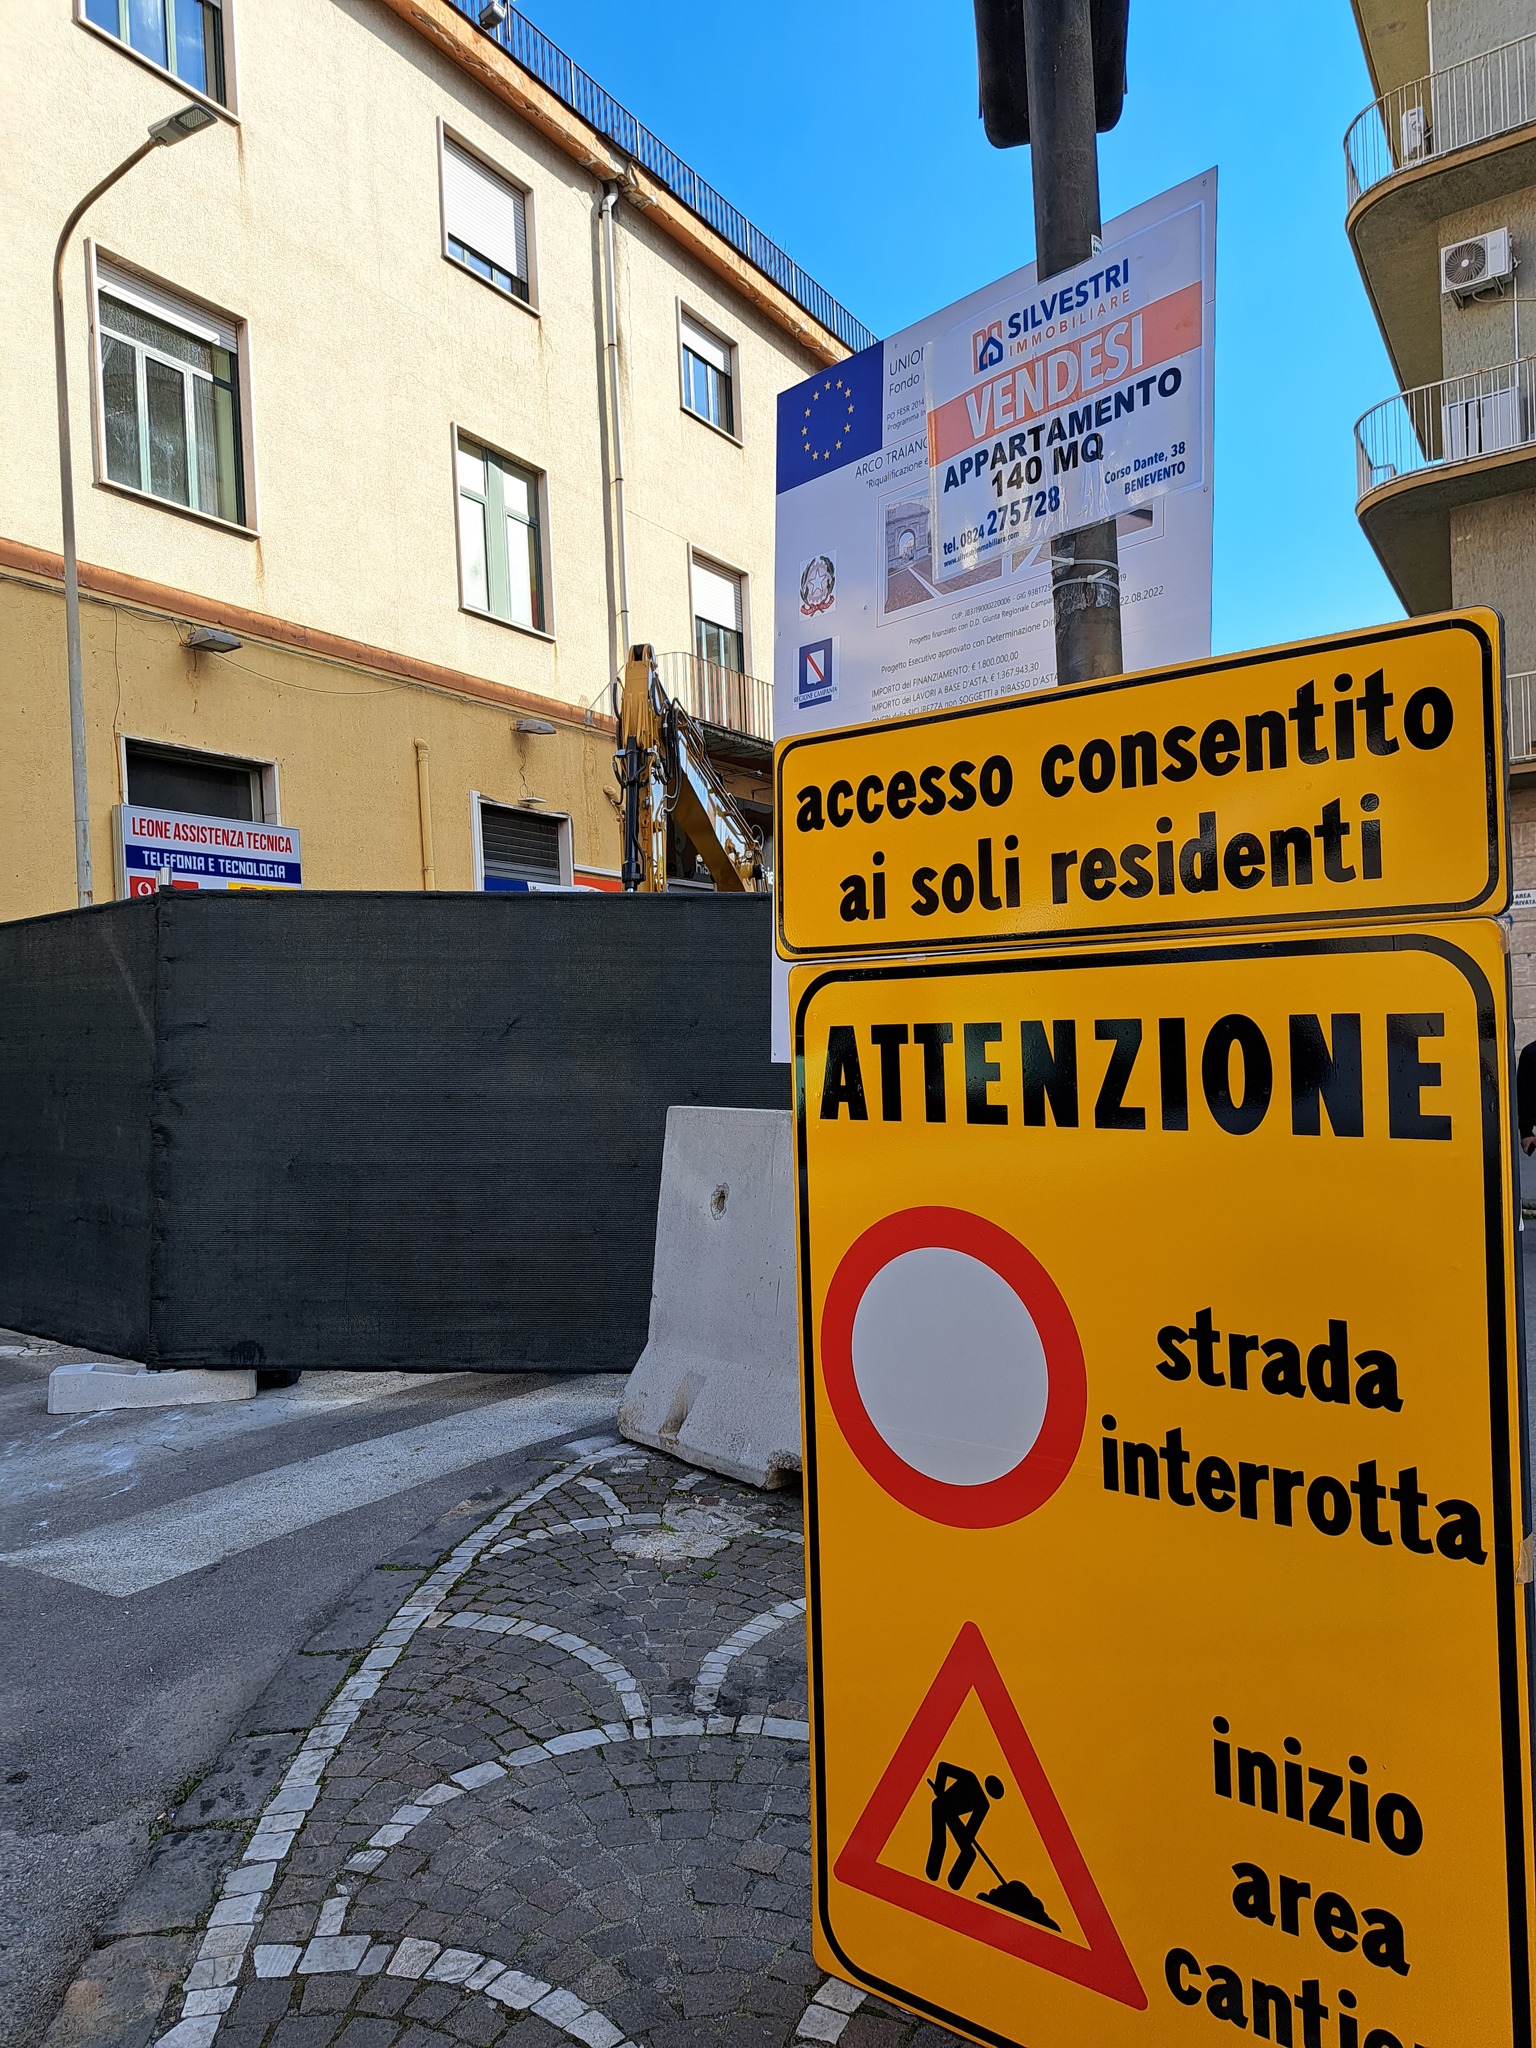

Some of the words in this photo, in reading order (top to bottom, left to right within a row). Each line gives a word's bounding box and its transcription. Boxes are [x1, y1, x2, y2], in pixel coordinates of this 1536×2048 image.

[1007, 258, 1129, 339] SILVESTRI
[1009, 289, 1130, 356] IMMOBILIARE
[889, 373, 920, 396] Fondo
[966, 313, 1143, 440] VENDESI
[887, 411, 896, 421] PO
[897, 404, 910, 417] FESR
[887, 412, 919, 432] Programma
[943, 367, 1182, 493] APPARTAMENTO
[855, 456, 884, 479] ARCO
[992, 456, 1042, 498] 140
[1053, 433, 1104, 475] MQ
[1104, 465, 1131, 485] Corso
[1133, 452, 1168, 473] Dante,
[1170, 441, 1186, 458] 38
[1124, 461, 1186, 495] BENEVENTO
[943, 536, 959, 556] tel.
[960, 524, 985, 548] 0824
[986, 486, 1061, 537] 275728
[881, 661, 908, 674] Progetto
[908, 652, 937, 667] Esecutivo
[937, 641, 971, 659] approvato
[972, 639, 985, 649] con
[986, 622, 1041, 645] Determinazione
[1120, 585, 1164, 606] 22.08.2022
[909, 634, 931, 646] Progetto
[932, 626, 957, 638] finanziato
[958, 620, 969, 631] con
[983, 611, 1000, 624] Giunta
[1002, 603, 1030, 618] Regionale
[793, 692, 813, 703] REGIONE
[813, 686, 838, 699] CAMPANIA
[872, 682, 901, 698] IMPORTO
[912, 664, 970, 687] FINANZIAMENTO:
[971, 662, 976, 671] €
[977, 650, 1019, 669] 1.800.000,00
[872, 697, 901, 713] IMPORTO
[912, 688, 937, 702] LAVORI
[937, 687, 943, 695] A
[944, 681, 960, 694] BASE
[990, 672, 995, 682] €
[996, 661, 1040, 681] 1.367.943,30
[944, 699, 958, 709] non
[959, 689, 993, 705] SOGGETTI
[994, 689, 999, 697] a
[1000, 679, 1031, 695] RIBASSO
[795, 754, 1013, 833] accesso
[1041, 667, 1454, 798] consentito
[132, 817, 171, 839] LEONE
[173, 822, 244, 848] ASSISTENZA
[246, 832, 293, 854] TECNICA
[142, 850, 205, 871] TELEFONIA
[208, 859, 215, 872] E
[218, 859, 286, 879] TECNOLOGIA
[839, 851, 886, 922] ai
[911, 834, 1020, 917] soli
[1051, 793, 1383, 904] residenti
[820, 1013, 1453, 1141] ATTENZIONE
[1155, 1307, 1404, 1413] strada
[1101, 1415, 1488, 1566] interrotta
[1212, 1715, 1423, 1857] inizio
[1231, 1862, 1411, 1977] area
[1164, 1947, 1429, 2048] canti
